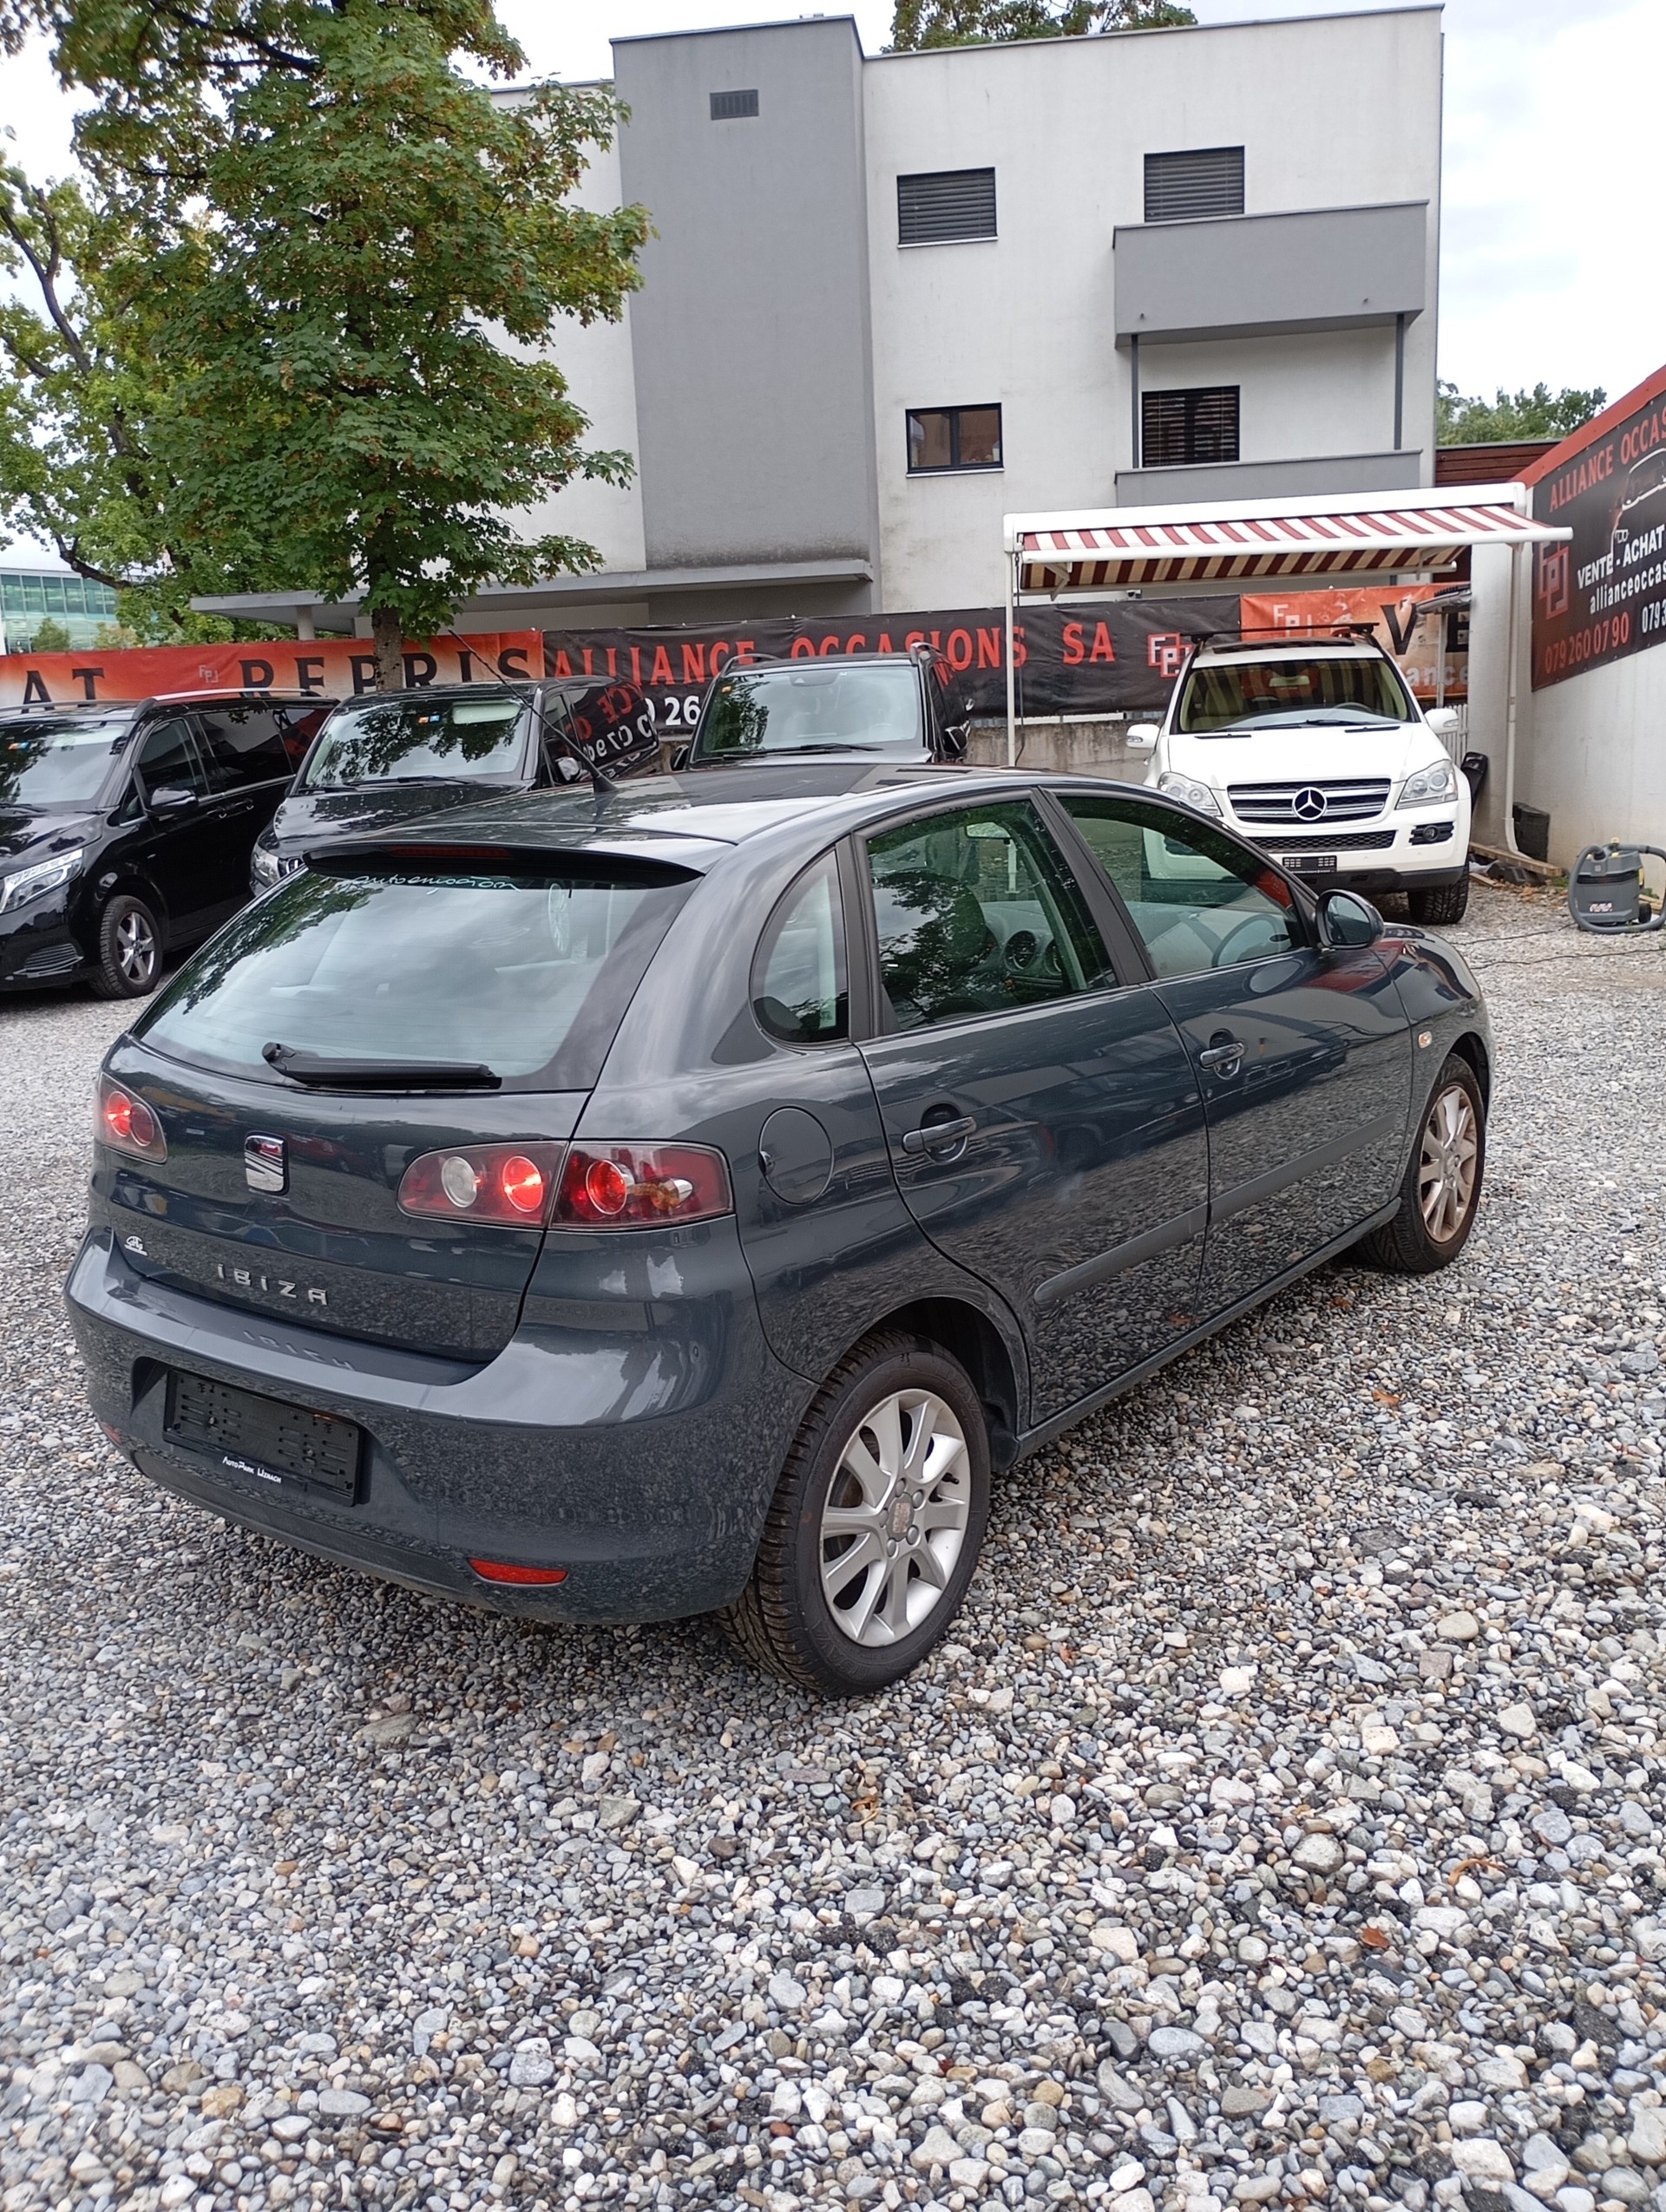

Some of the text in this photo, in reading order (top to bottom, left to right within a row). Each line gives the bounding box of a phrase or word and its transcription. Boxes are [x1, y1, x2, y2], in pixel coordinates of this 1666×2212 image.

[1549, 443, 1614, 513] ALLIANCE
[1577, 552, 1614, 590] VENTE
[1623, 524, 1665, 567] ACHAT
[1062, 621, 1115, 664] SA
[1568, 628, 1591, 665] 260
[1594, 619, 1610, 654] 07
[1612, 611, 1629, 647] 90
[217, 1263, 328, 1306] IBIZA
